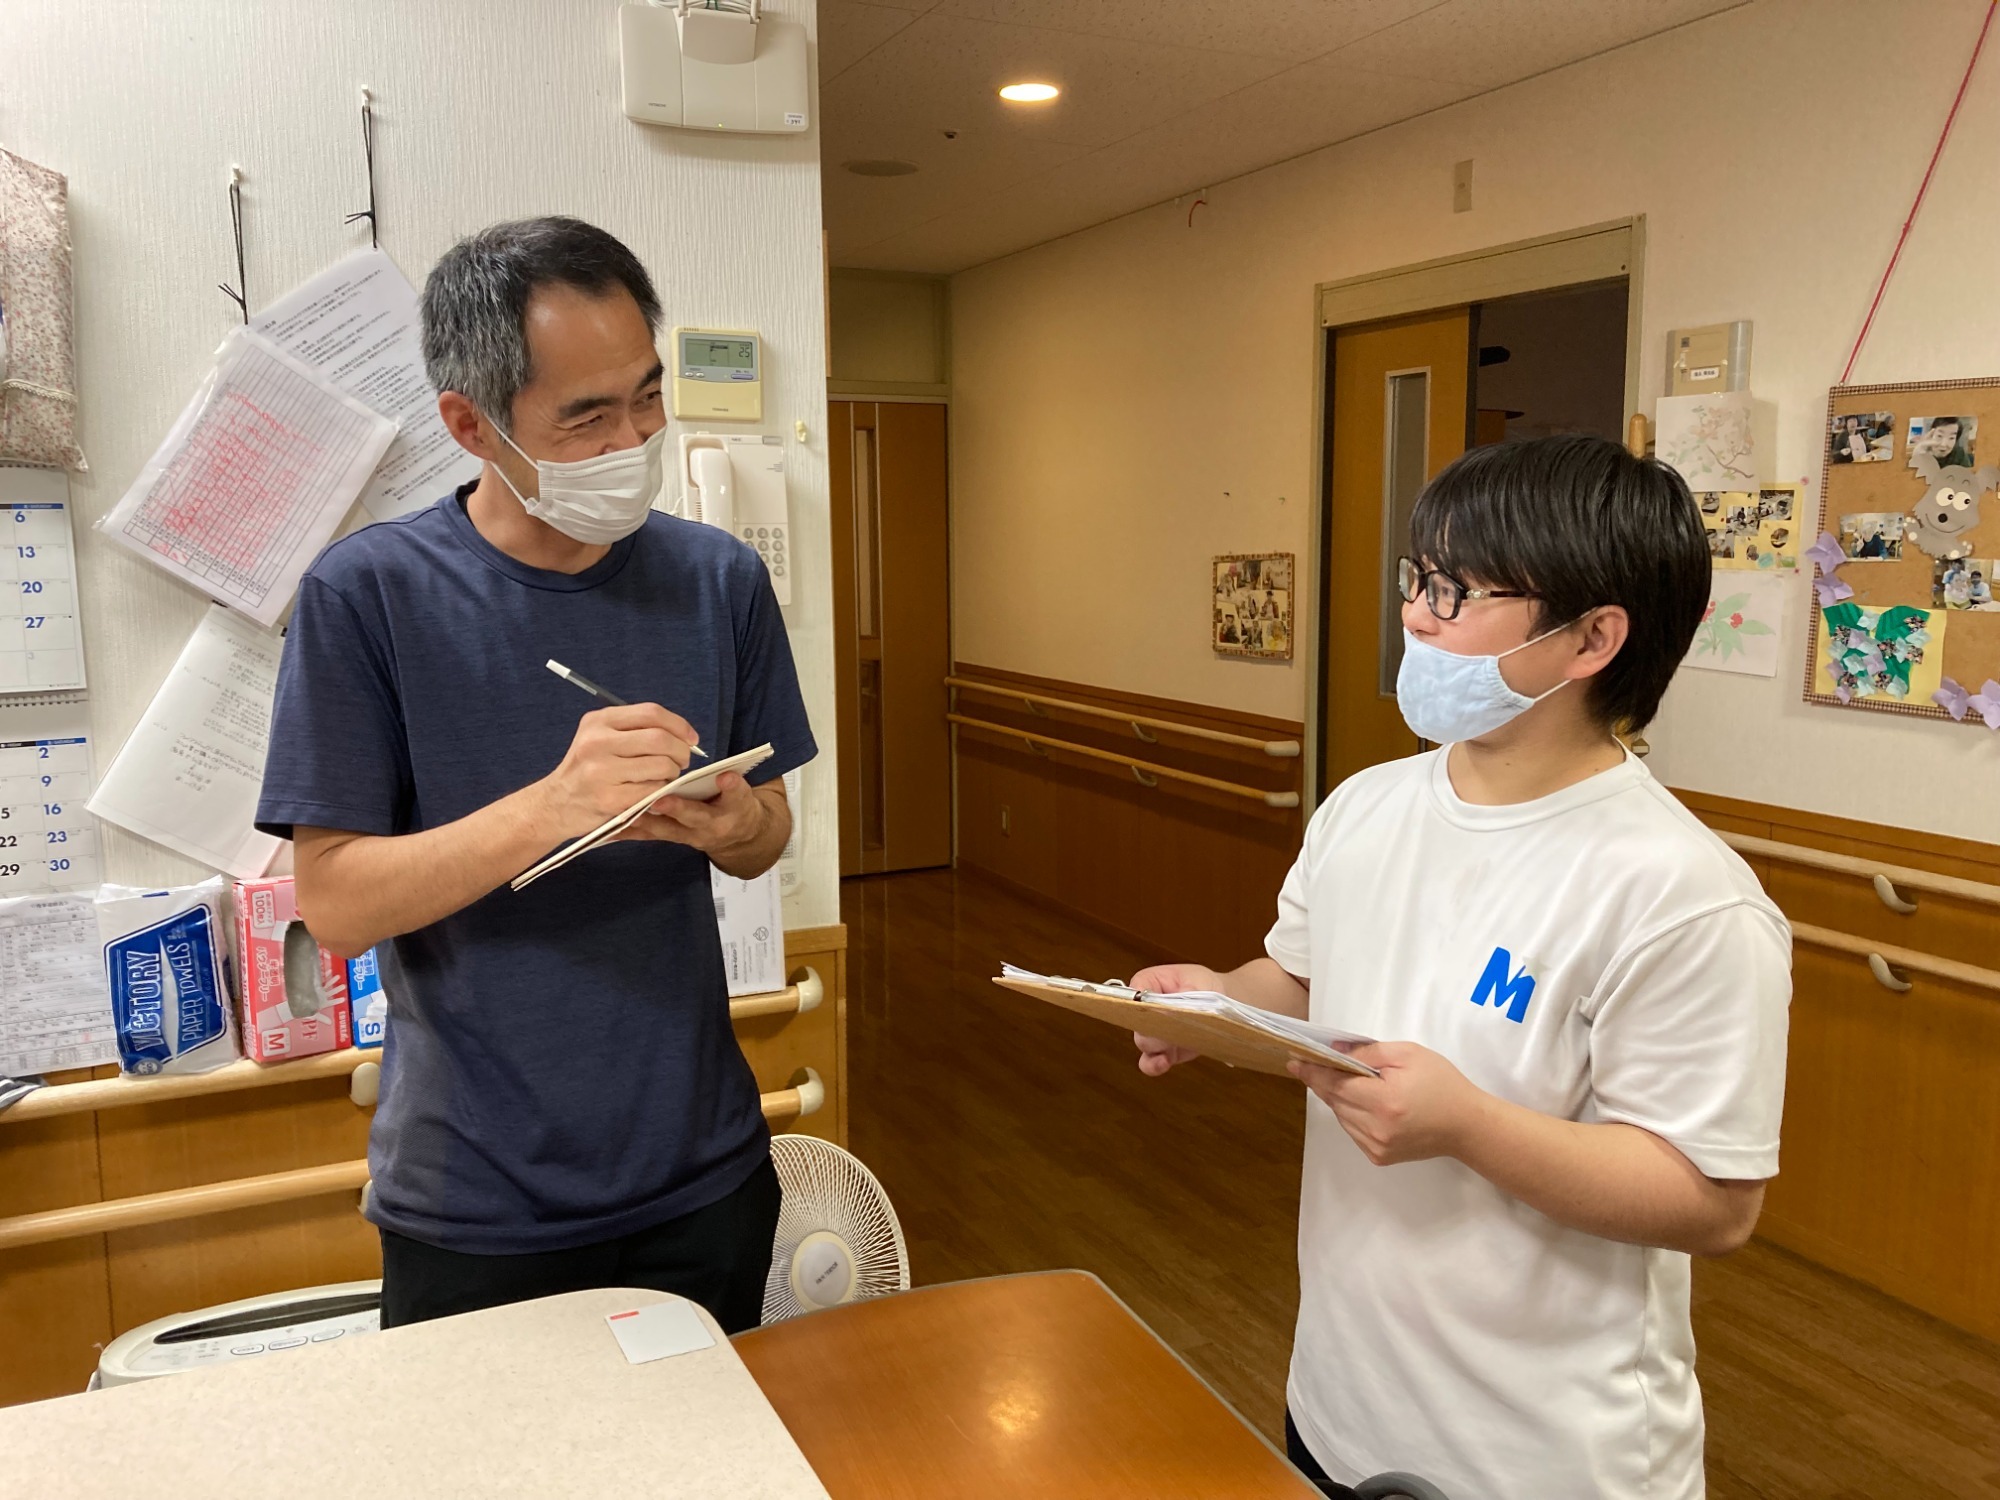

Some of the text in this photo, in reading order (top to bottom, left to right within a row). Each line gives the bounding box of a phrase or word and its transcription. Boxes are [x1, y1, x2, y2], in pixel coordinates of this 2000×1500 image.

[738, 346, 751, 358] 25
[15, 511, 26, 523] 6
[17, 546, 36, 558] 13
[21, 581, 43, 593] 20
[25, 616, 46, 629] 27
[39, 747, 49, 758] 2
[41, 776, 52, 787] 9
[43, 803, 62, 815] 16
[0, 835, 18, 848] 22
[47, 831, 67, 843] 23
[0, 863, 20, 876] 29
[49, 858, 70, 871] 30
[167, 941, 201, 998] TOWELS
[256, 946, 268, 1002] パウダーフリー
[270, 959, 281, 987] 半透明
[127, 950, 165, 1052] VICTORY
[182, 998, 204, 1042] PAPER
[365, 1022, 381, 1036] S
[268, 1032, 285, 1051] M
